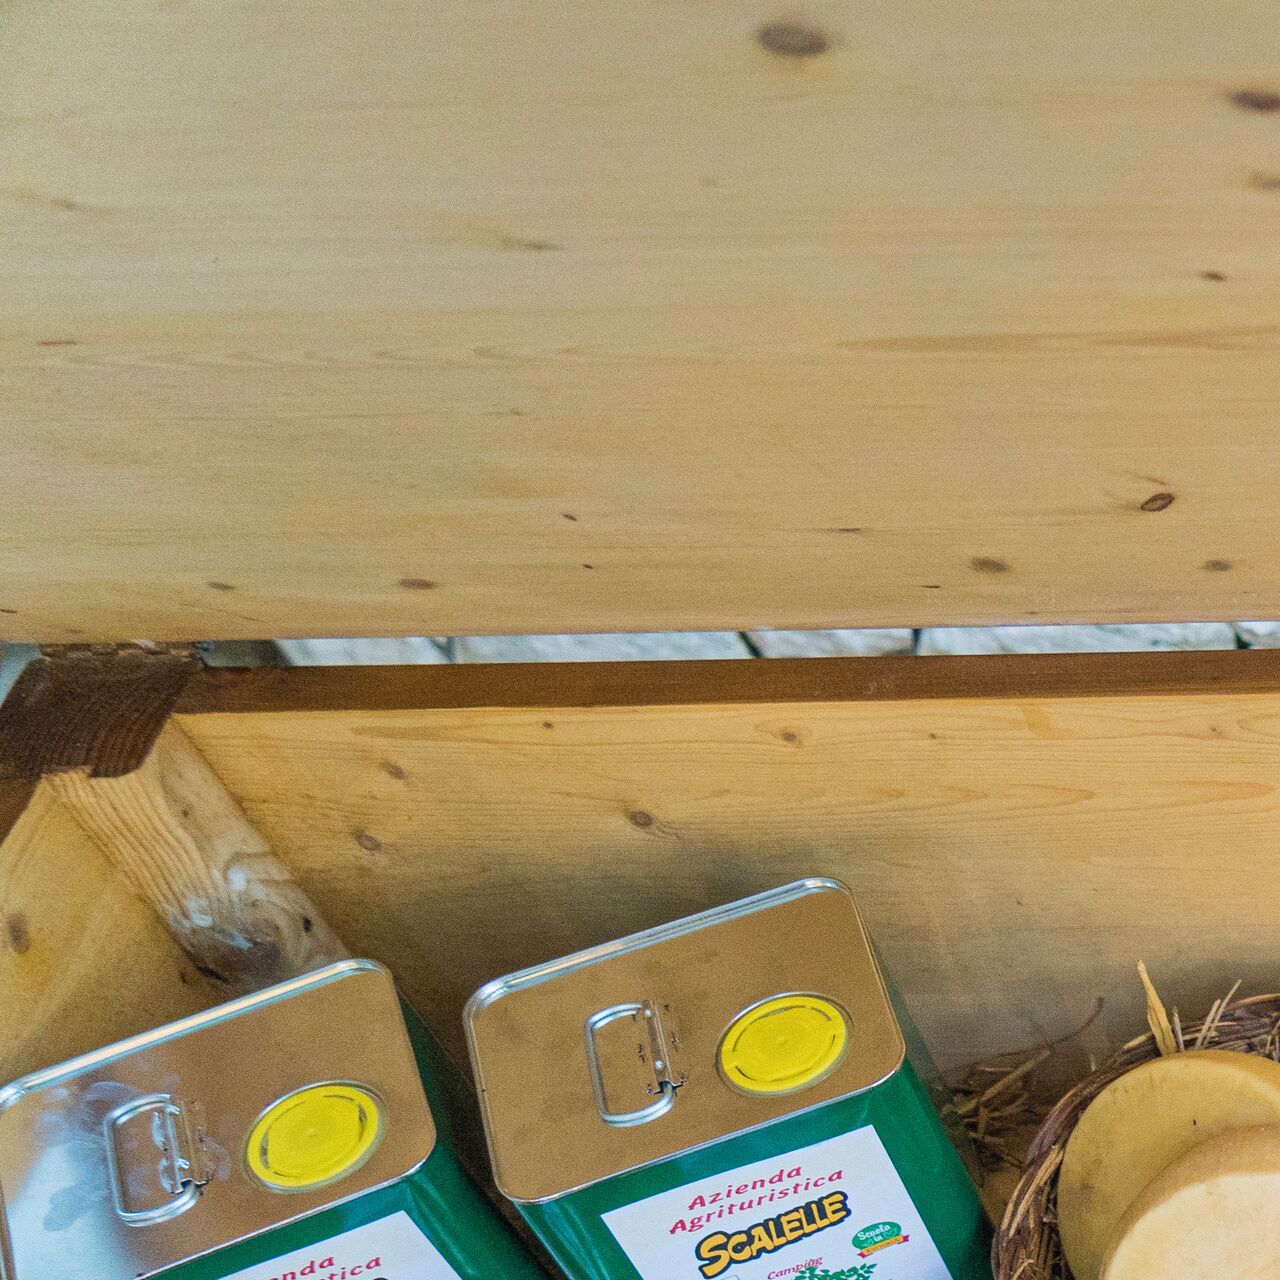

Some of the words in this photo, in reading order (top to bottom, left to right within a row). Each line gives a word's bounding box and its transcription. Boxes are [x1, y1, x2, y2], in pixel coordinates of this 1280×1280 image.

[668, 1169, 842, 1234] Agrituristica
[687, 1166, 801, 1210] Azienda
[694, 1190, 851, 1279] SCALELLE
[853, 1224, 891, 1240] Scuola
[767, 1256, 822, 1280] Camping
